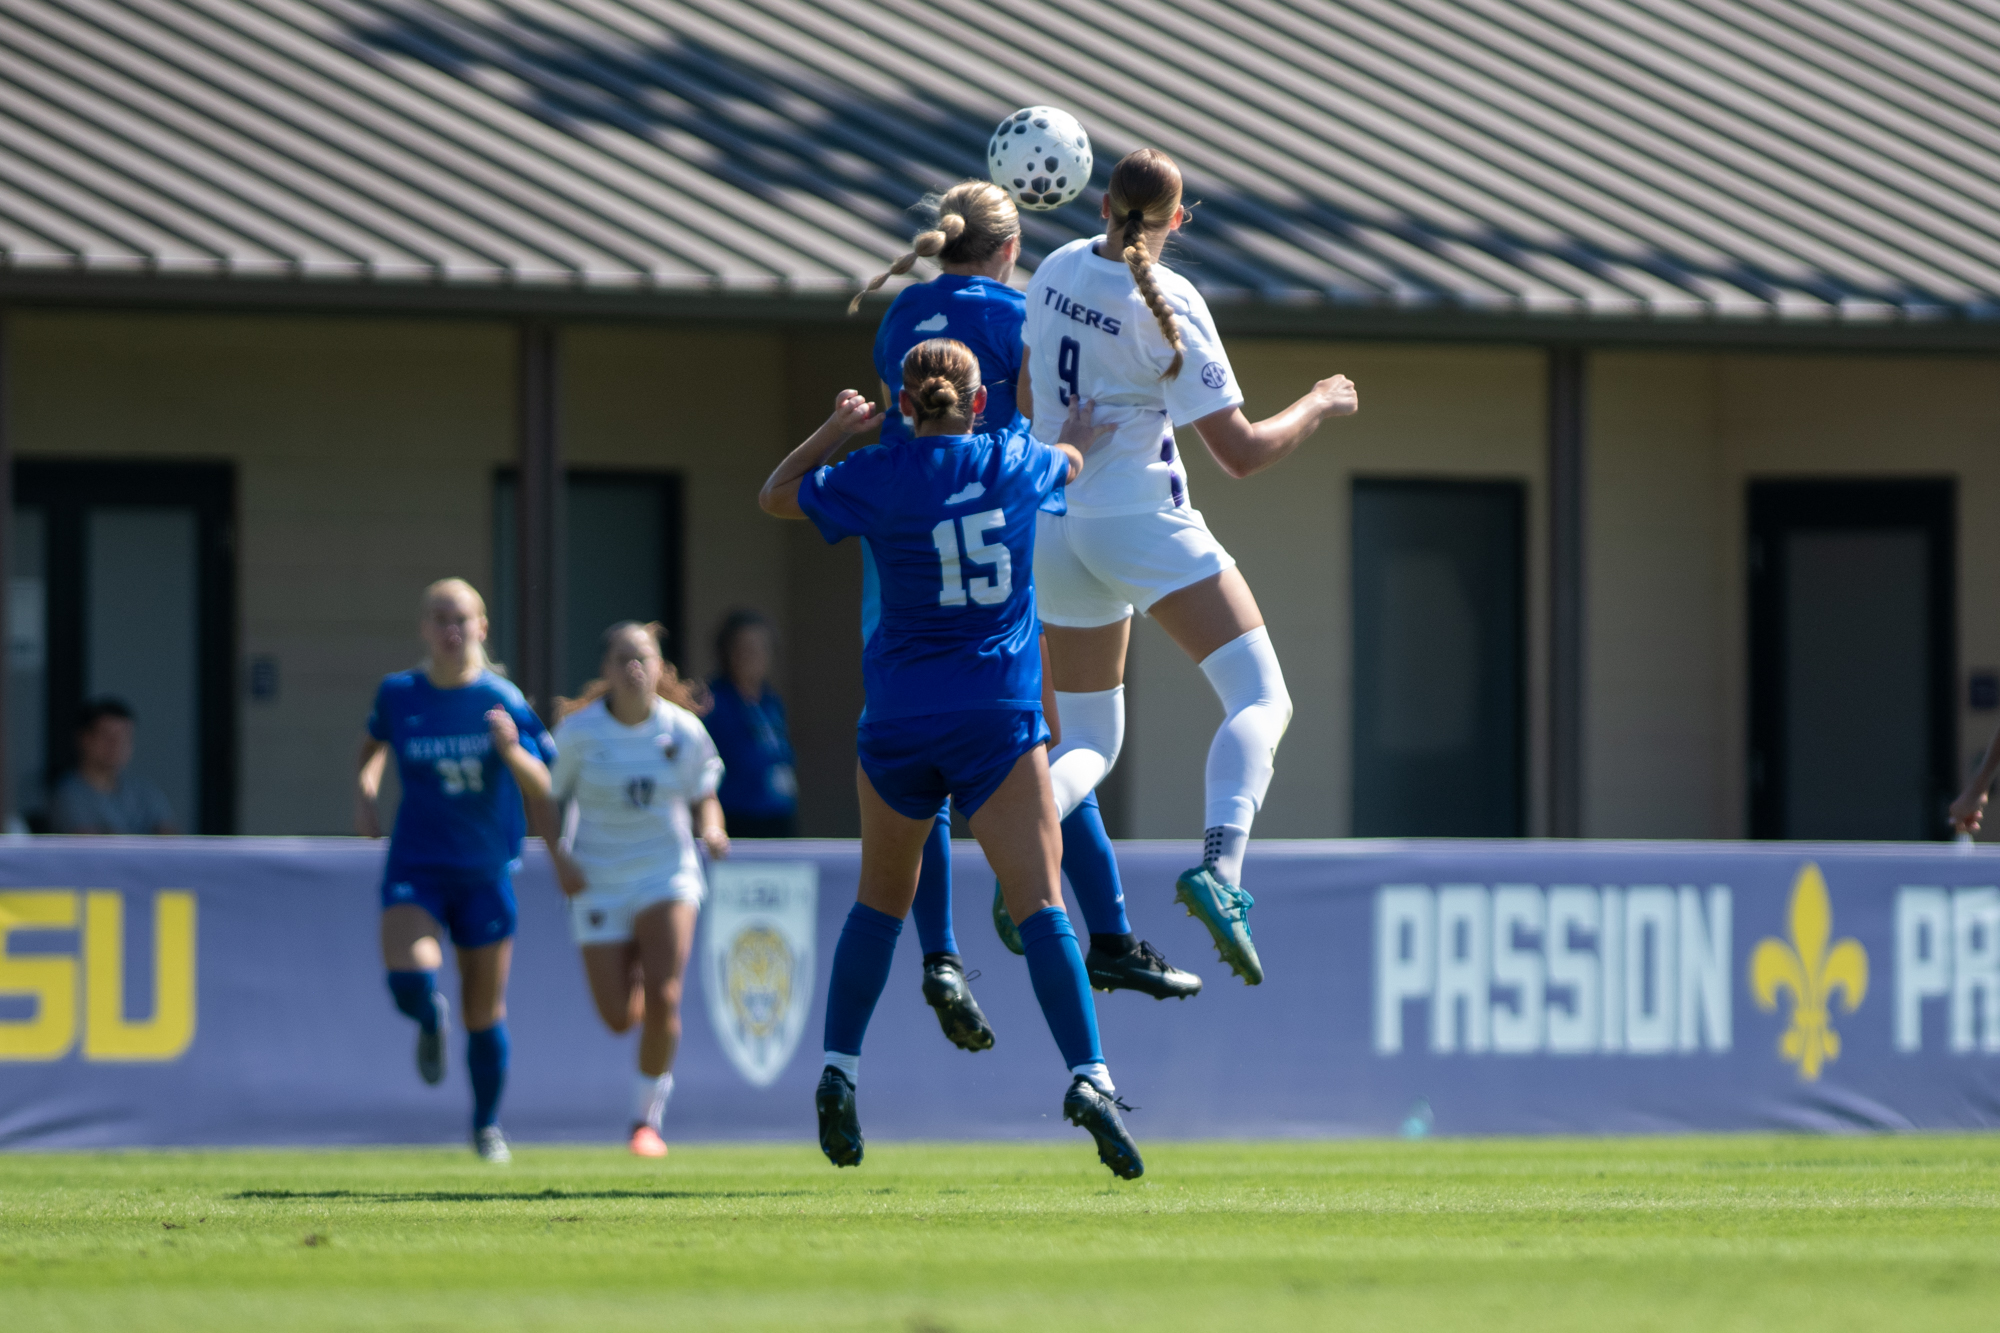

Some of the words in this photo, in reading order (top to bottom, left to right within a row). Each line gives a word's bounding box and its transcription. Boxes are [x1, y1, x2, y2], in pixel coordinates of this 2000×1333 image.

[1058, 335, 1080, 407] 9
[1202, 362, 1227, 389] SEC
[932, 508, 1013, 606] 15
[1374, 883, 1733, 1055] PASSION
